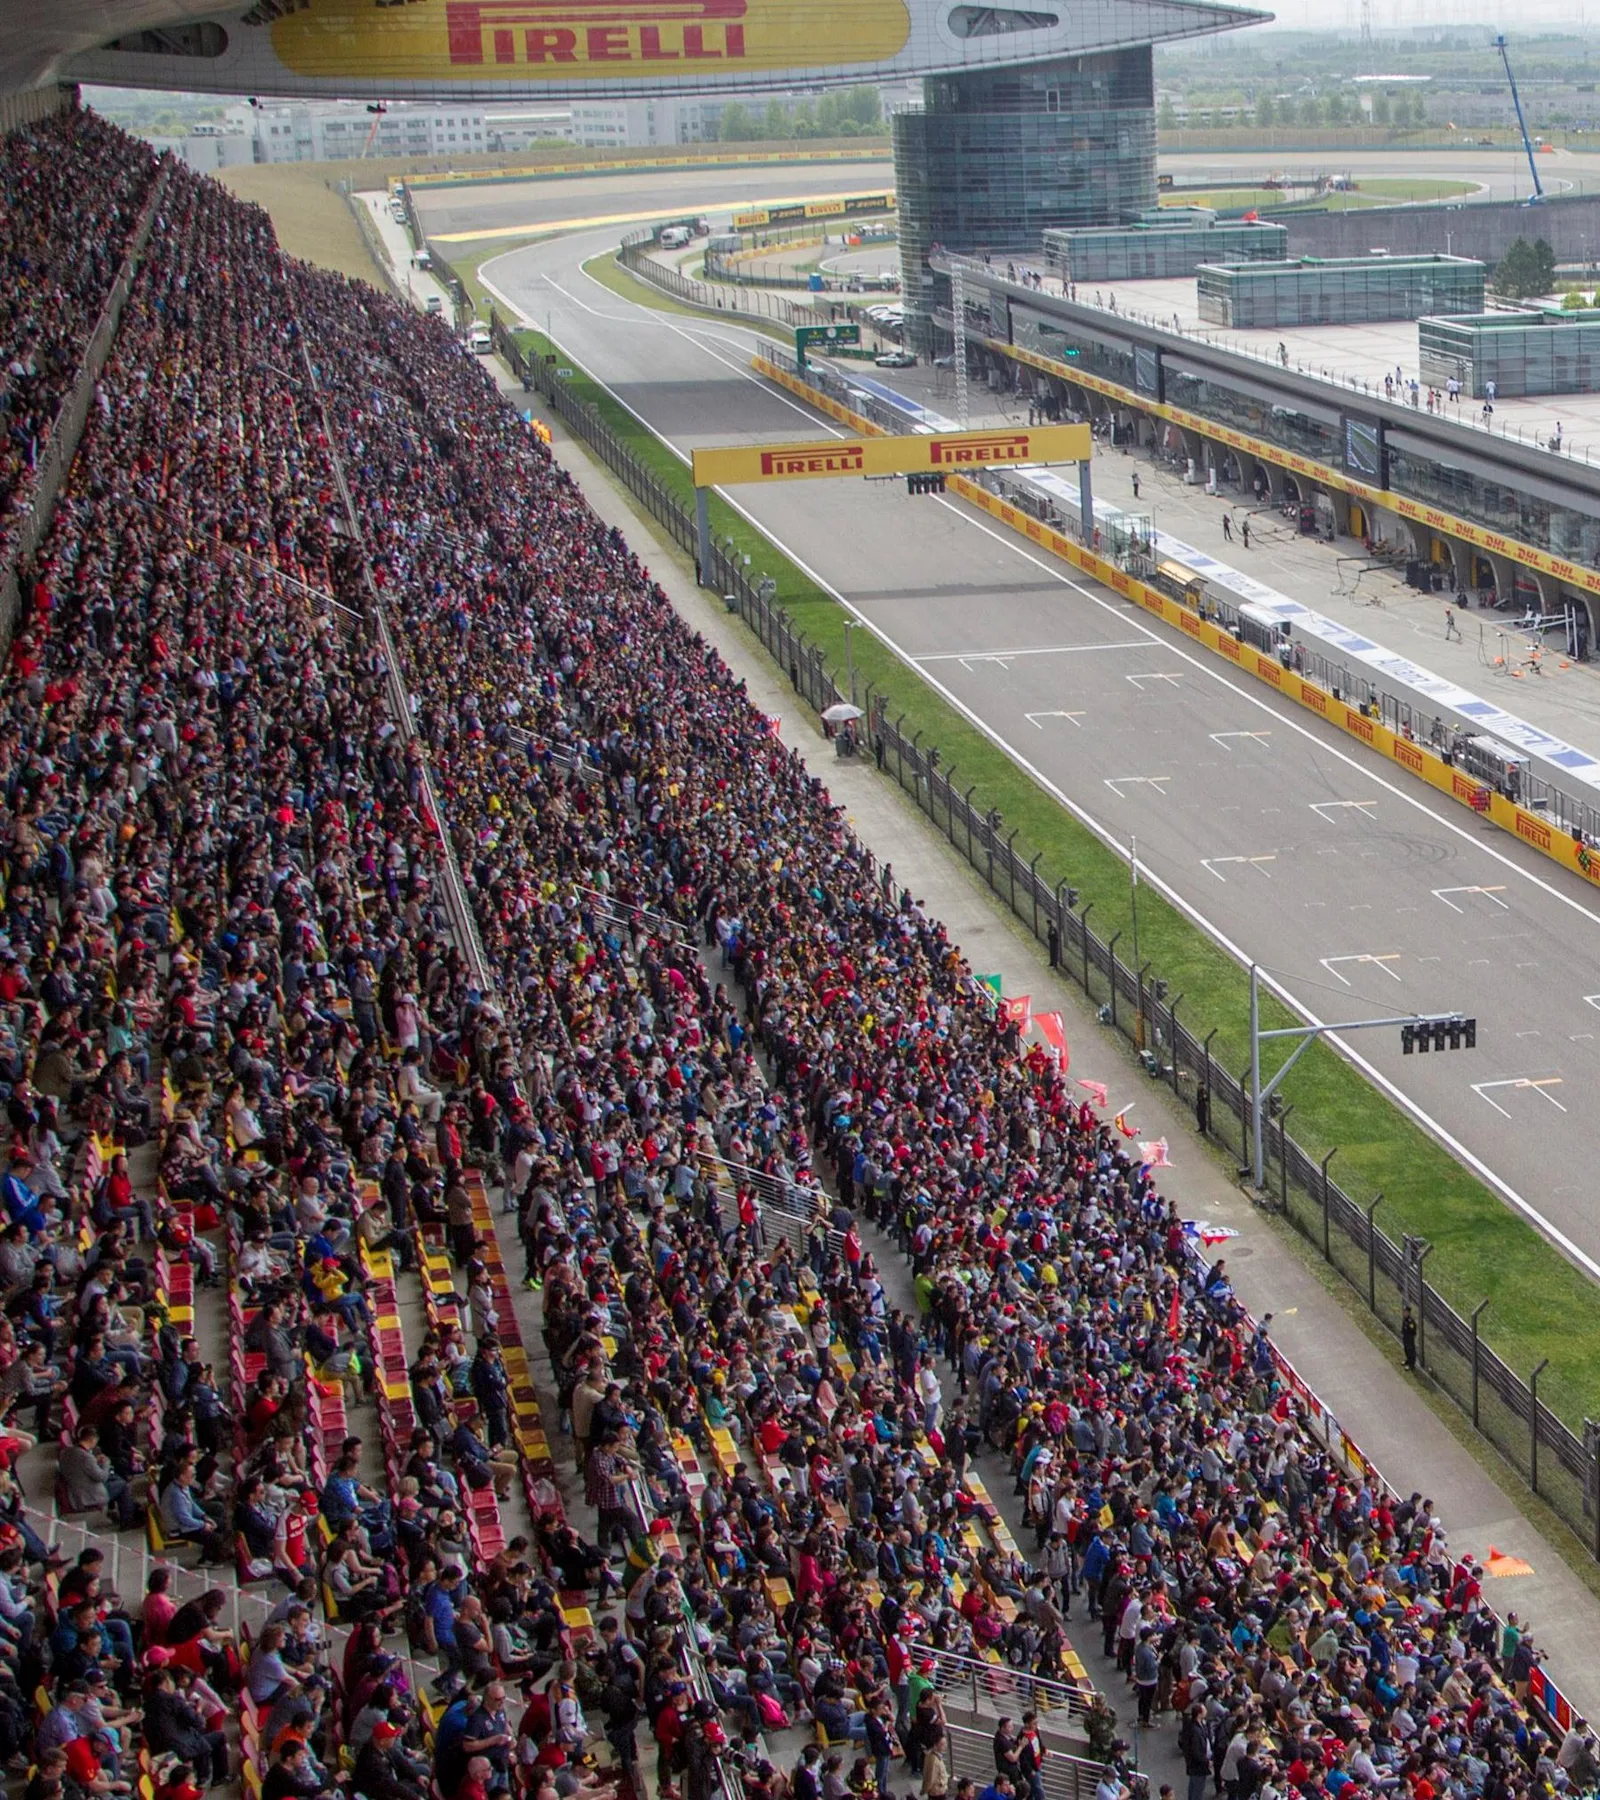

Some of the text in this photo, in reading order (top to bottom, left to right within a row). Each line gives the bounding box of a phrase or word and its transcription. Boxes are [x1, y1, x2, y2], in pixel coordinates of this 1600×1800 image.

[446, 0, 747, 65] PIRELLI
[810, 203, 842, 214] PIRELLI
[761, 447, 863, 476] PIRELLI
[930, 436, 1029, 464] PIRELLI
[1398, 500, 1417, 517] DHL
[1427, 511, 1446, 528] DHL
[1455, 522, 1476, 540] DHL
[1486, 534, 1507, 552] DHL
[1518, 547, 1541, 566] DHL
[1551, 560, 1575, 580] DHL
[1258, 657, 1280, 685] PIRELLI
[1301, 684, 1326, 713] PIRELLI
[1347, 711, 1373, 742] PIRELLI
[1394, 738, 1423, 772] PIRELLI
[1515, 812, 1551, 850] PIRELLI
